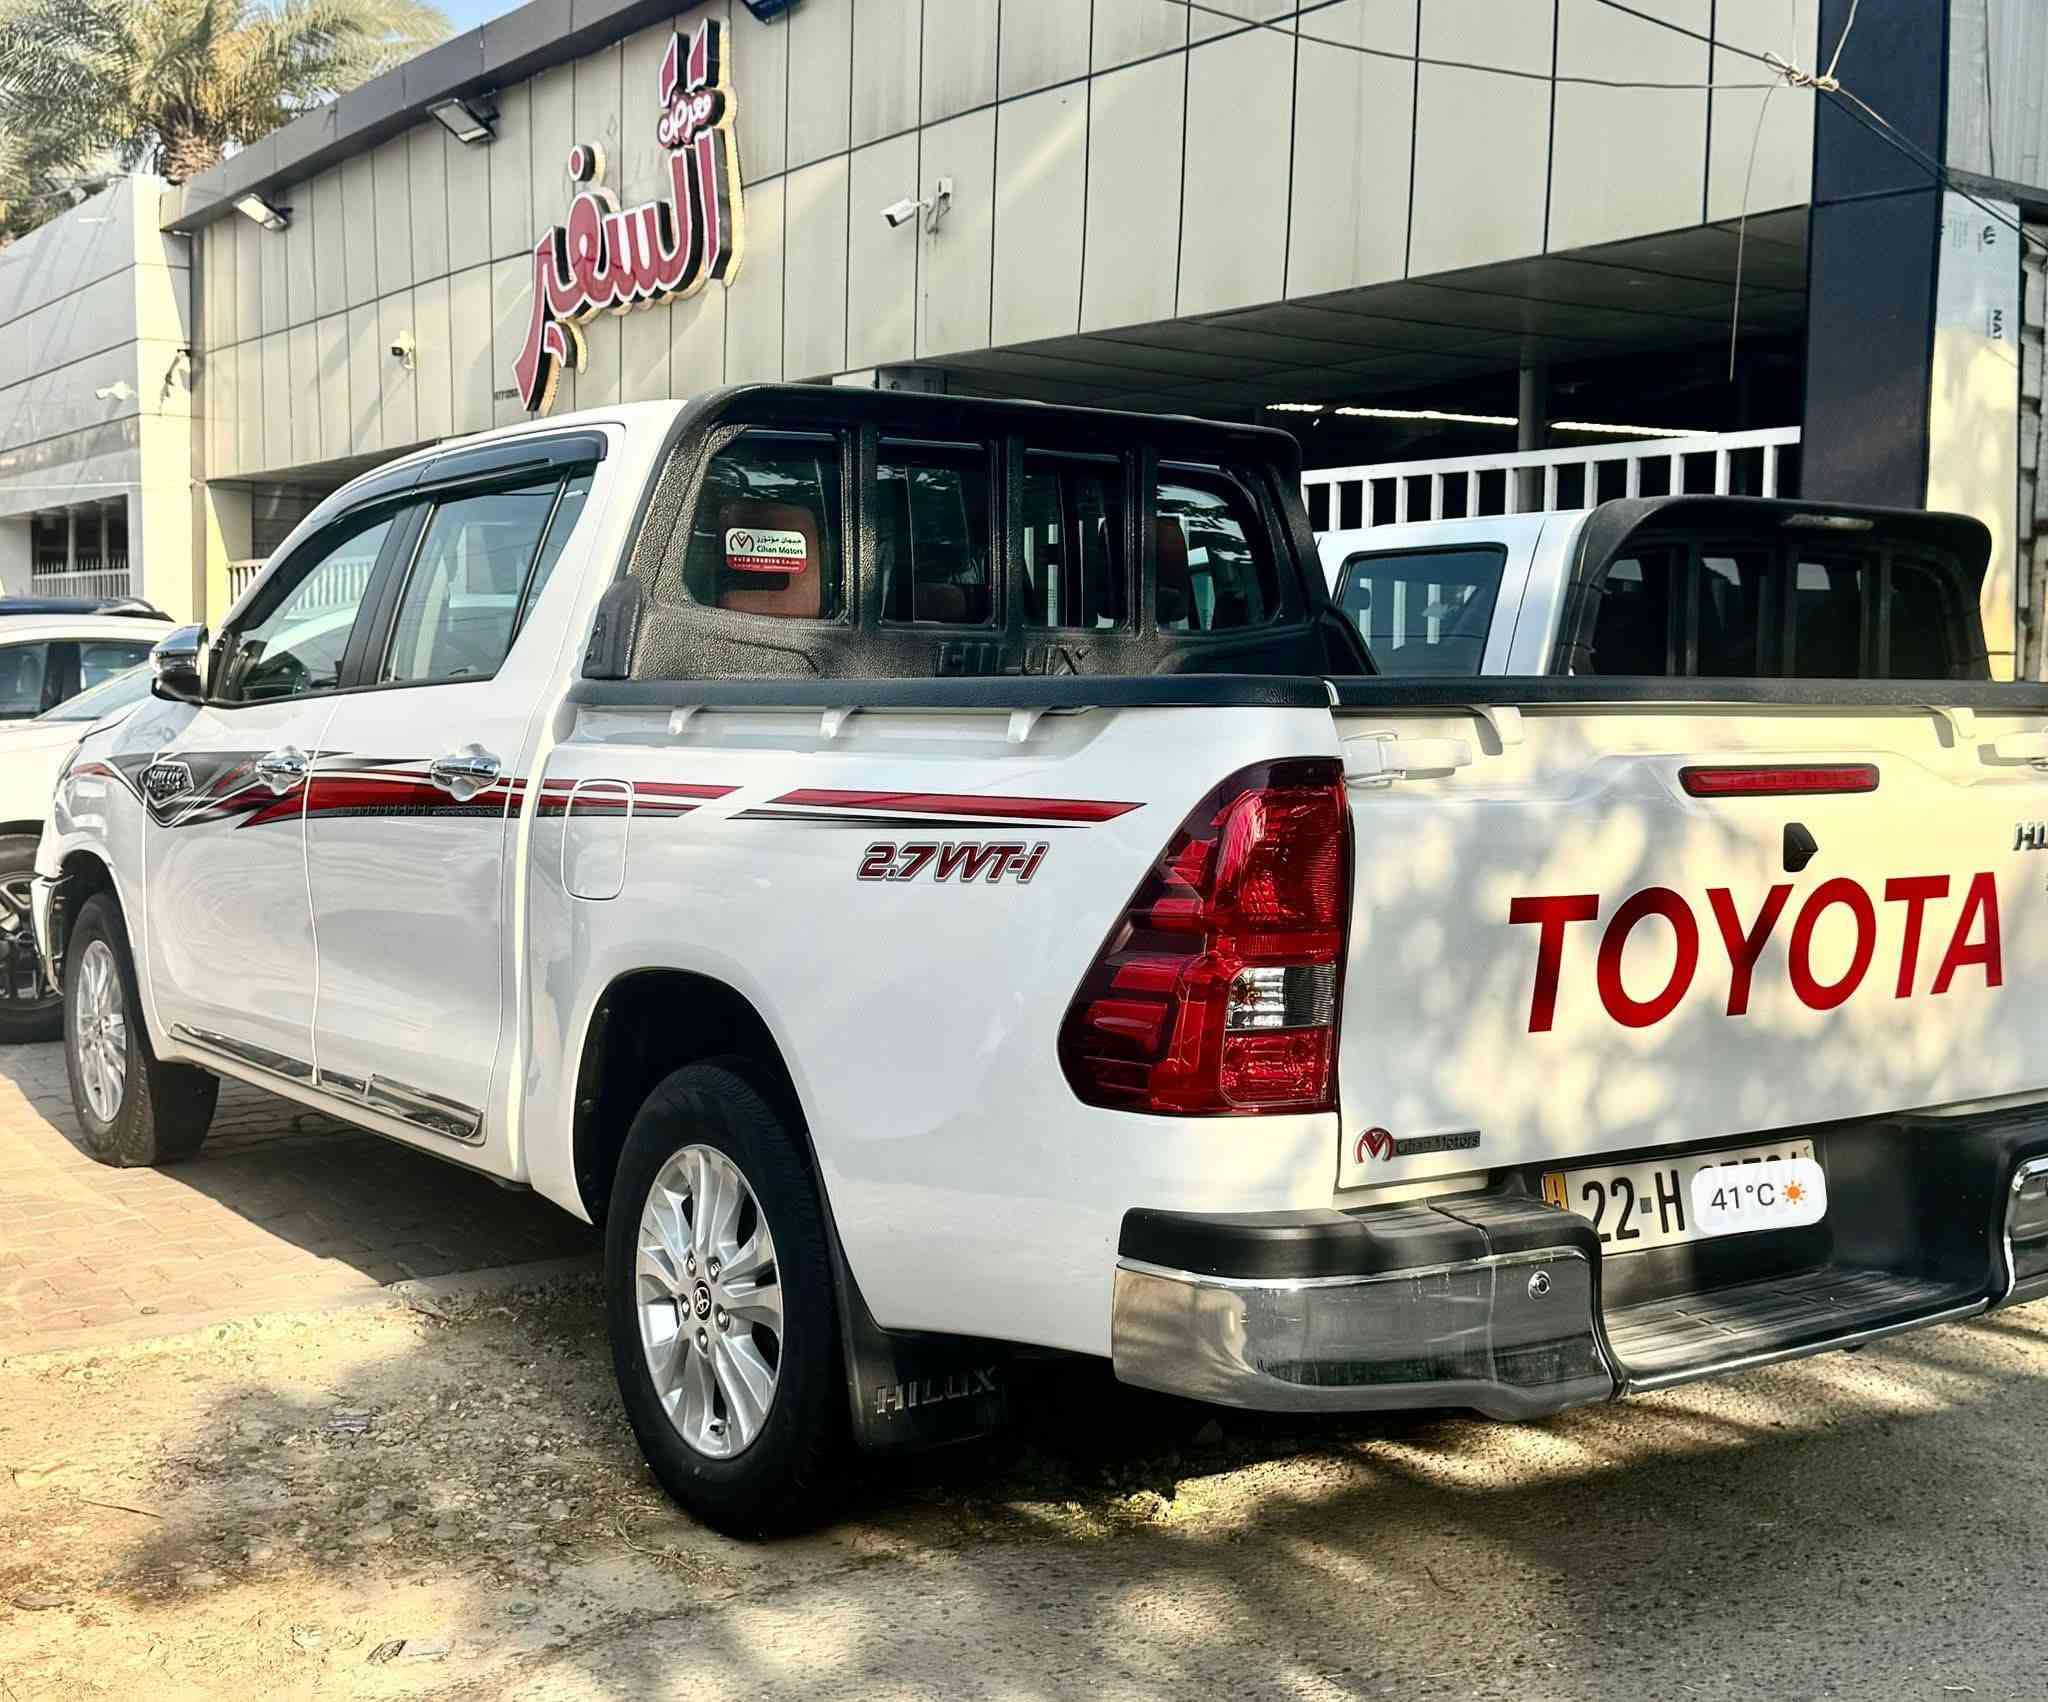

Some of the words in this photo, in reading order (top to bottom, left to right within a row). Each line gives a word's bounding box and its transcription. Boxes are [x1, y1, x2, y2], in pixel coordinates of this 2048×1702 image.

[658, 92, 714, 146] معرض
[511, 17, 731, 411] السفير
[757, 545, 777, 553] Cihan
[778, 547, 803, 555] Motors
[934, 642, 1090, 676] HILUX
[2012, 823, 2048, 851] HI
[1508, 871, 2004, 1033] TOYOTA
[876, 1366, 998, 1414] HILUX
